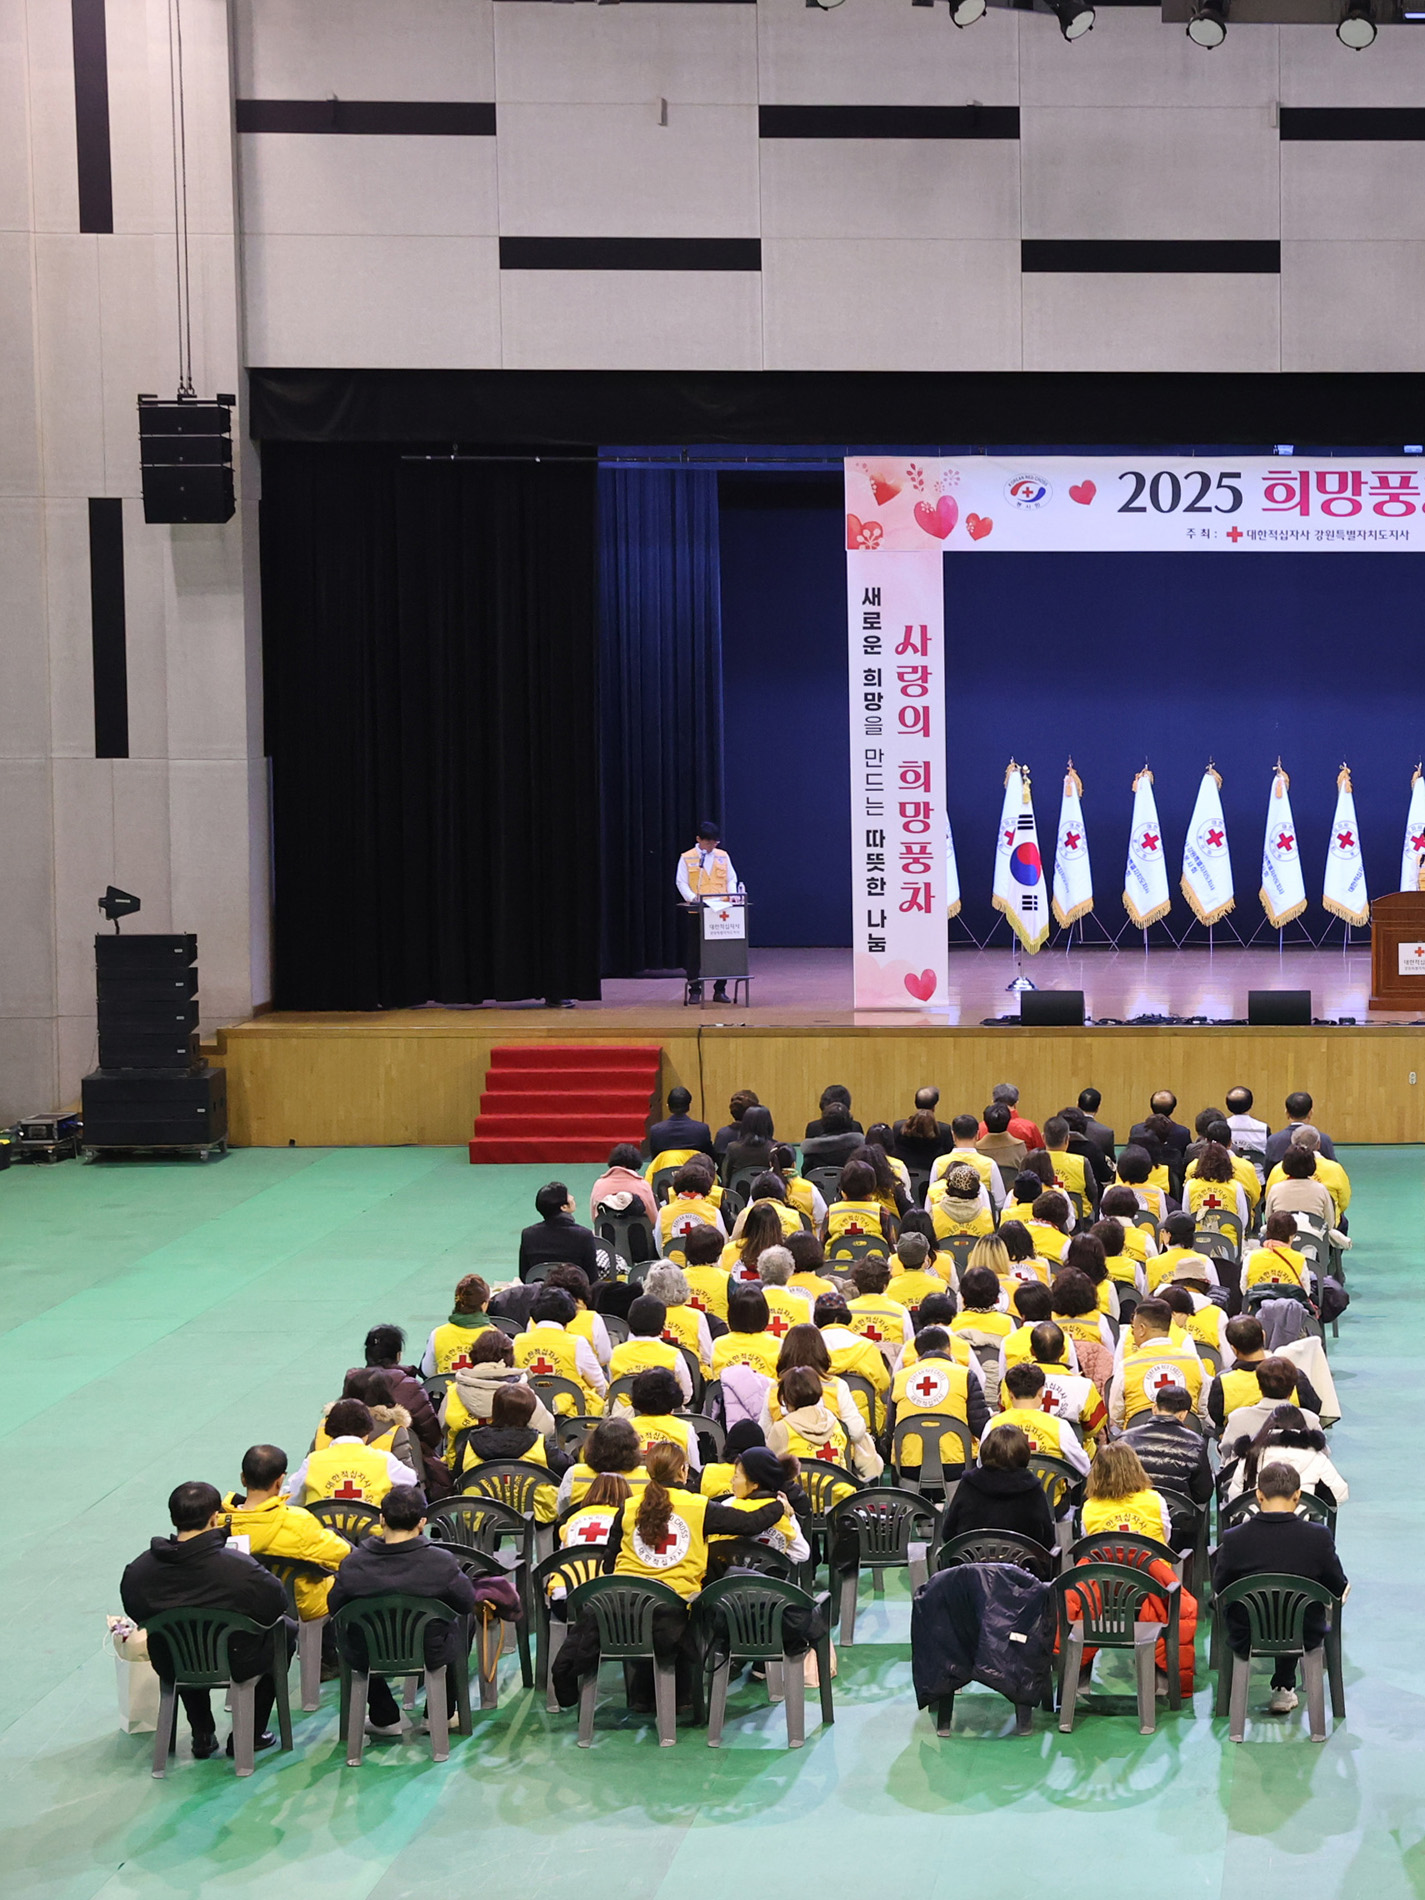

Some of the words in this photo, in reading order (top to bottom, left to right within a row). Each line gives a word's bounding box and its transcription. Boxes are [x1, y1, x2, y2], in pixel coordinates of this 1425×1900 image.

[1117, 471, 1243, 513] 2025
[1247, 529, 1310, 541] 대한적십자사
[1314, 529, 1410, 541] 강원특별자치도지사
[862, 587, 882, 655] 새로운
[863, 668, 883, 736] 희망을
[895, 625, 933, 737] 사랑의
[865, 748, 885, 816] 만드는
[897, 761, 936, 914] 희망풍차
[865, 829, 887, 896] 따뜻한
[867, 909, 887, 953] 나눔
[444, 1346, 473, 1362] 대한적십
[524, 1348, 560, 1366] 대한적십자사
[326, 1470, 371, 1489] 대한적십자사
[674, 1515, 689, 1539] CROSS
[638, 1546, 683, 1567] 대한적십자사
